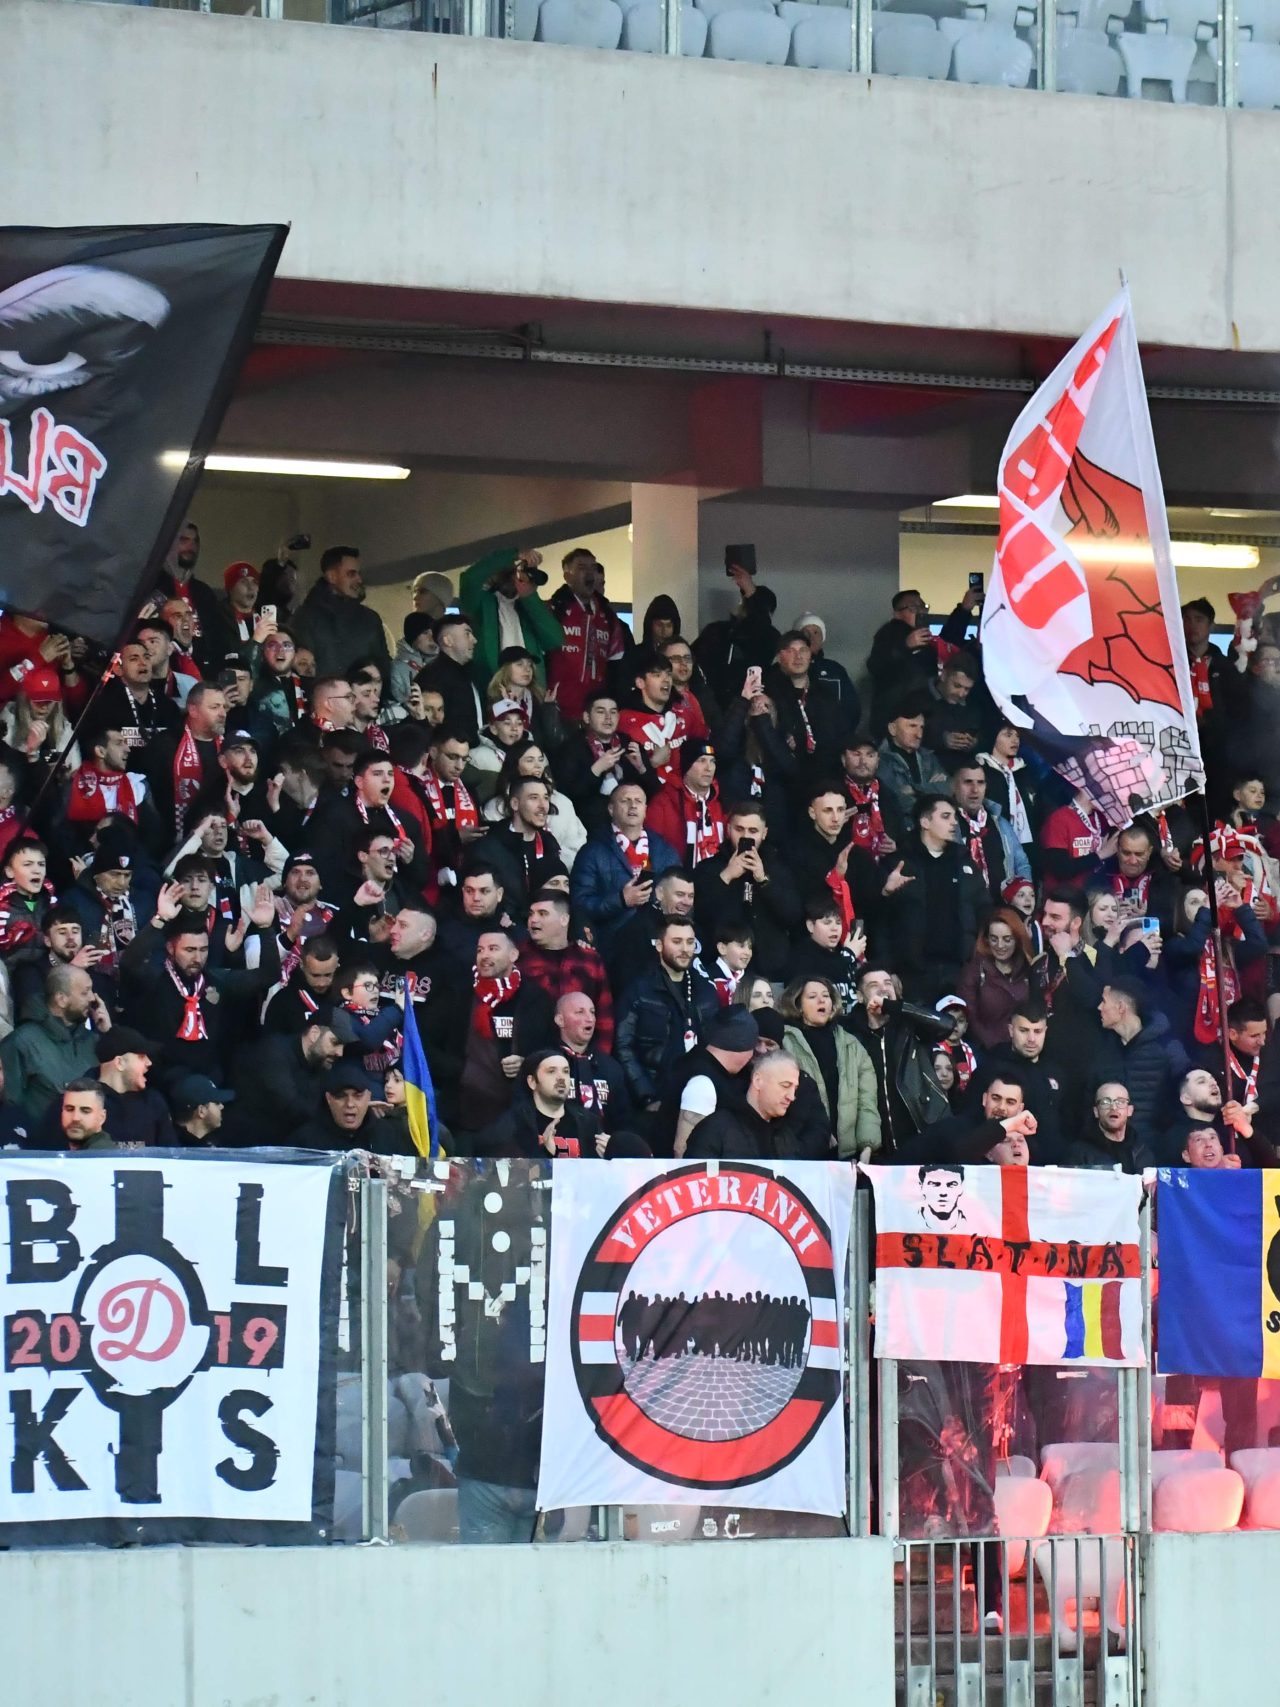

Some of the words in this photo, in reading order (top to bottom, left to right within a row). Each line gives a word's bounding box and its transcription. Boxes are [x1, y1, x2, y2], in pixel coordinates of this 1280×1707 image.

[611, 1176, 820, 1255] VETERANII
[902, 1233, 1126, 1278] SLATINA
[10, 1315, 82, 1365] 20
[214, 1315, 279, 1366] 19
